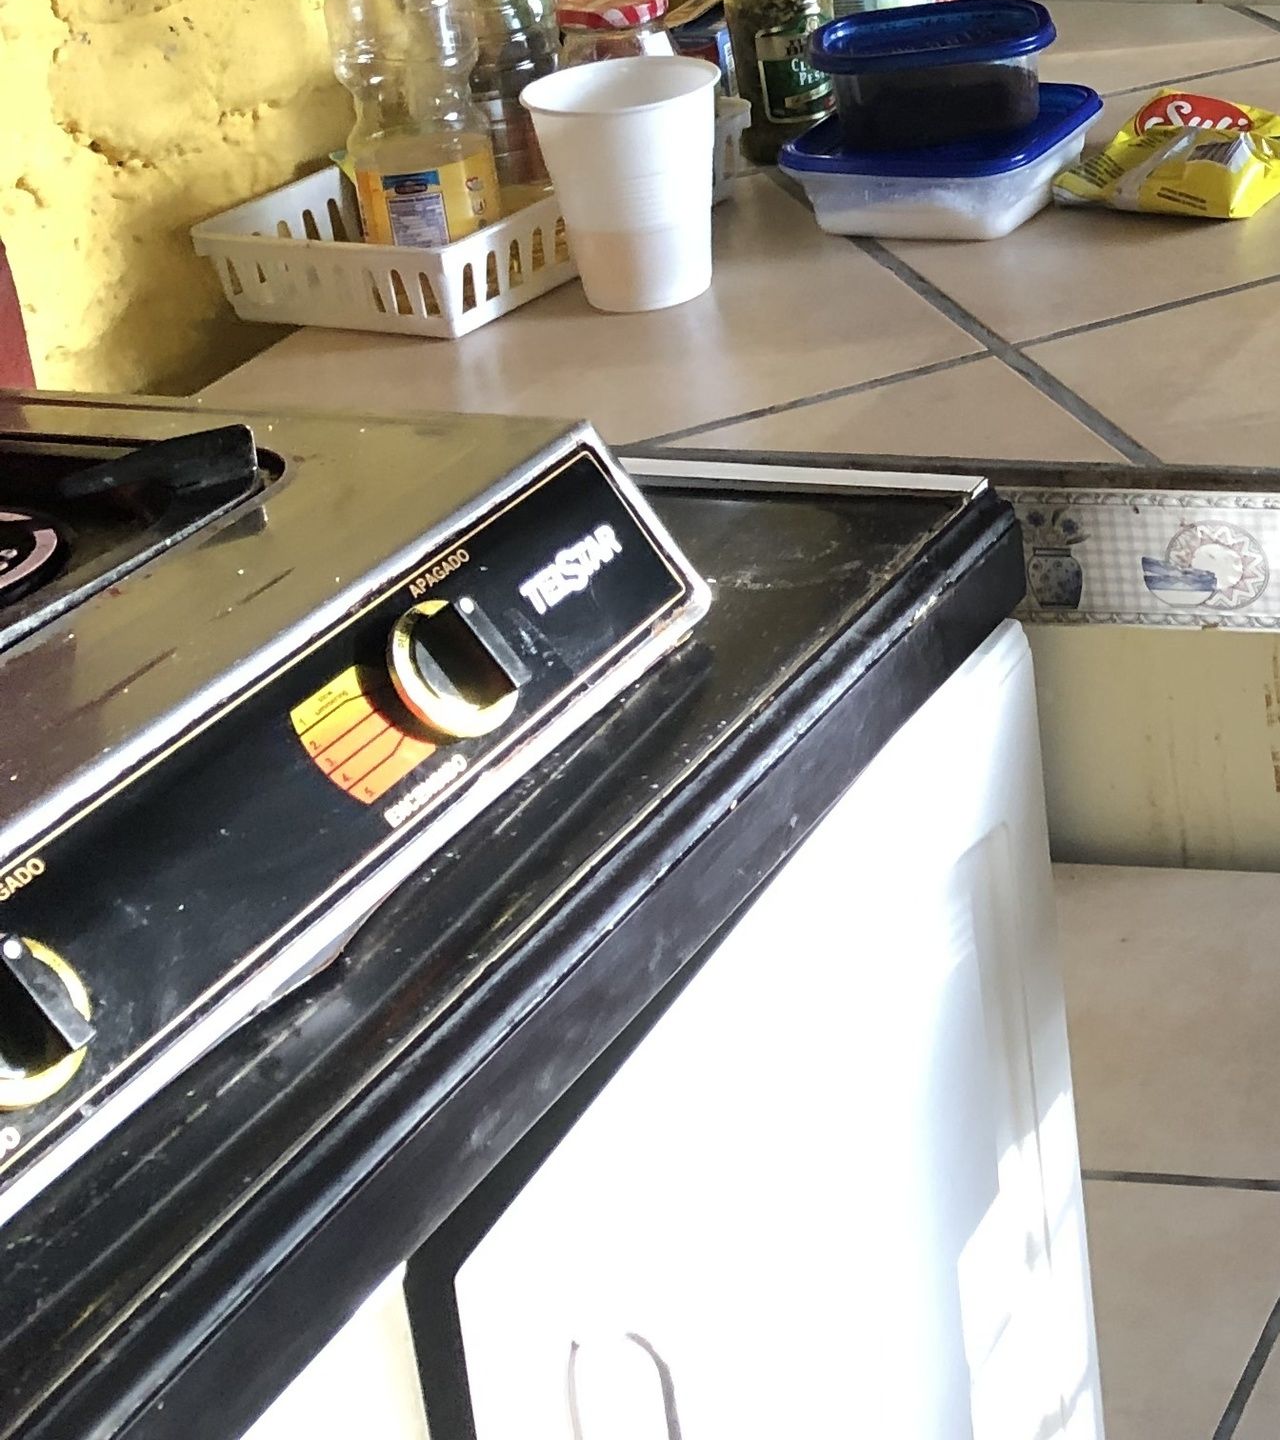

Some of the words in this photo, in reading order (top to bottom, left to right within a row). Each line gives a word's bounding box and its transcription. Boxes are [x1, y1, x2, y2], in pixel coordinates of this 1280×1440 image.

[408, 548, 470, 598] APAGADO
[309, 739, 321, 750] 2
[364, 786, 375, 798] 5
